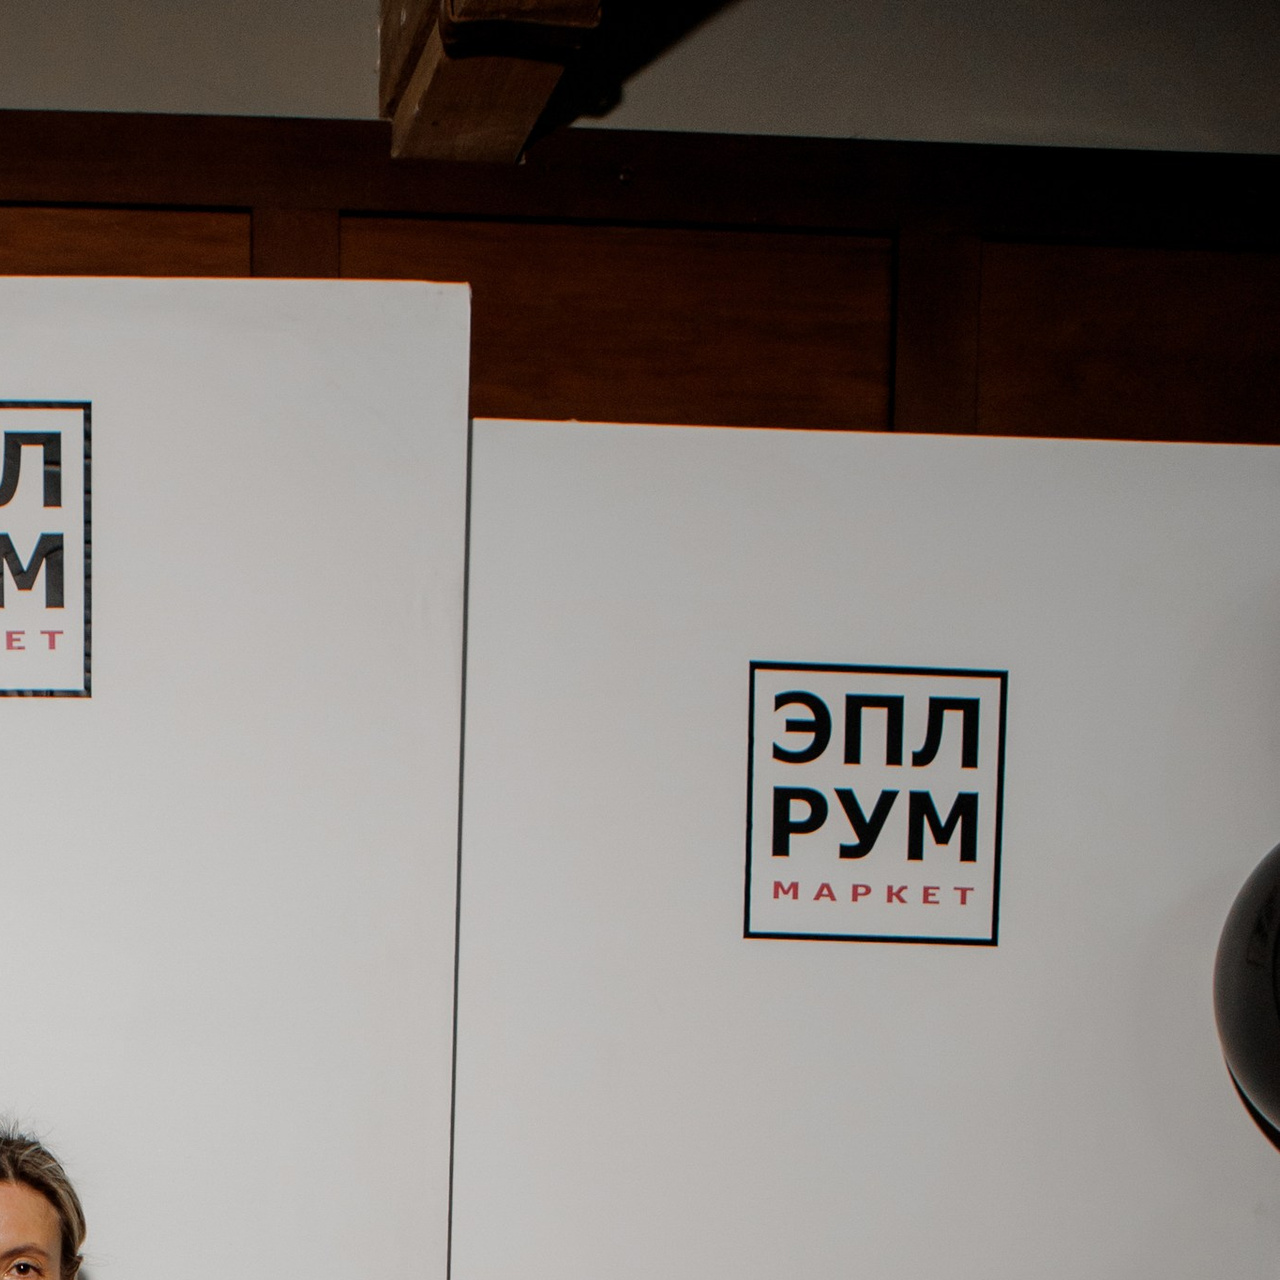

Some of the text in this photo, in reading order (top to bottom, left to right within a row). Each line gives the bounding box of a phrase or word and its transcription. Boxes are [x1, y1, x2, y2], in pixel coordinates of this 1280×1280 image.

[772, 690, 980, 769] ЭПЛ
[772, 785, 979, 863] РУМ
[773, 881, 974, 905] МАРКЕТ
